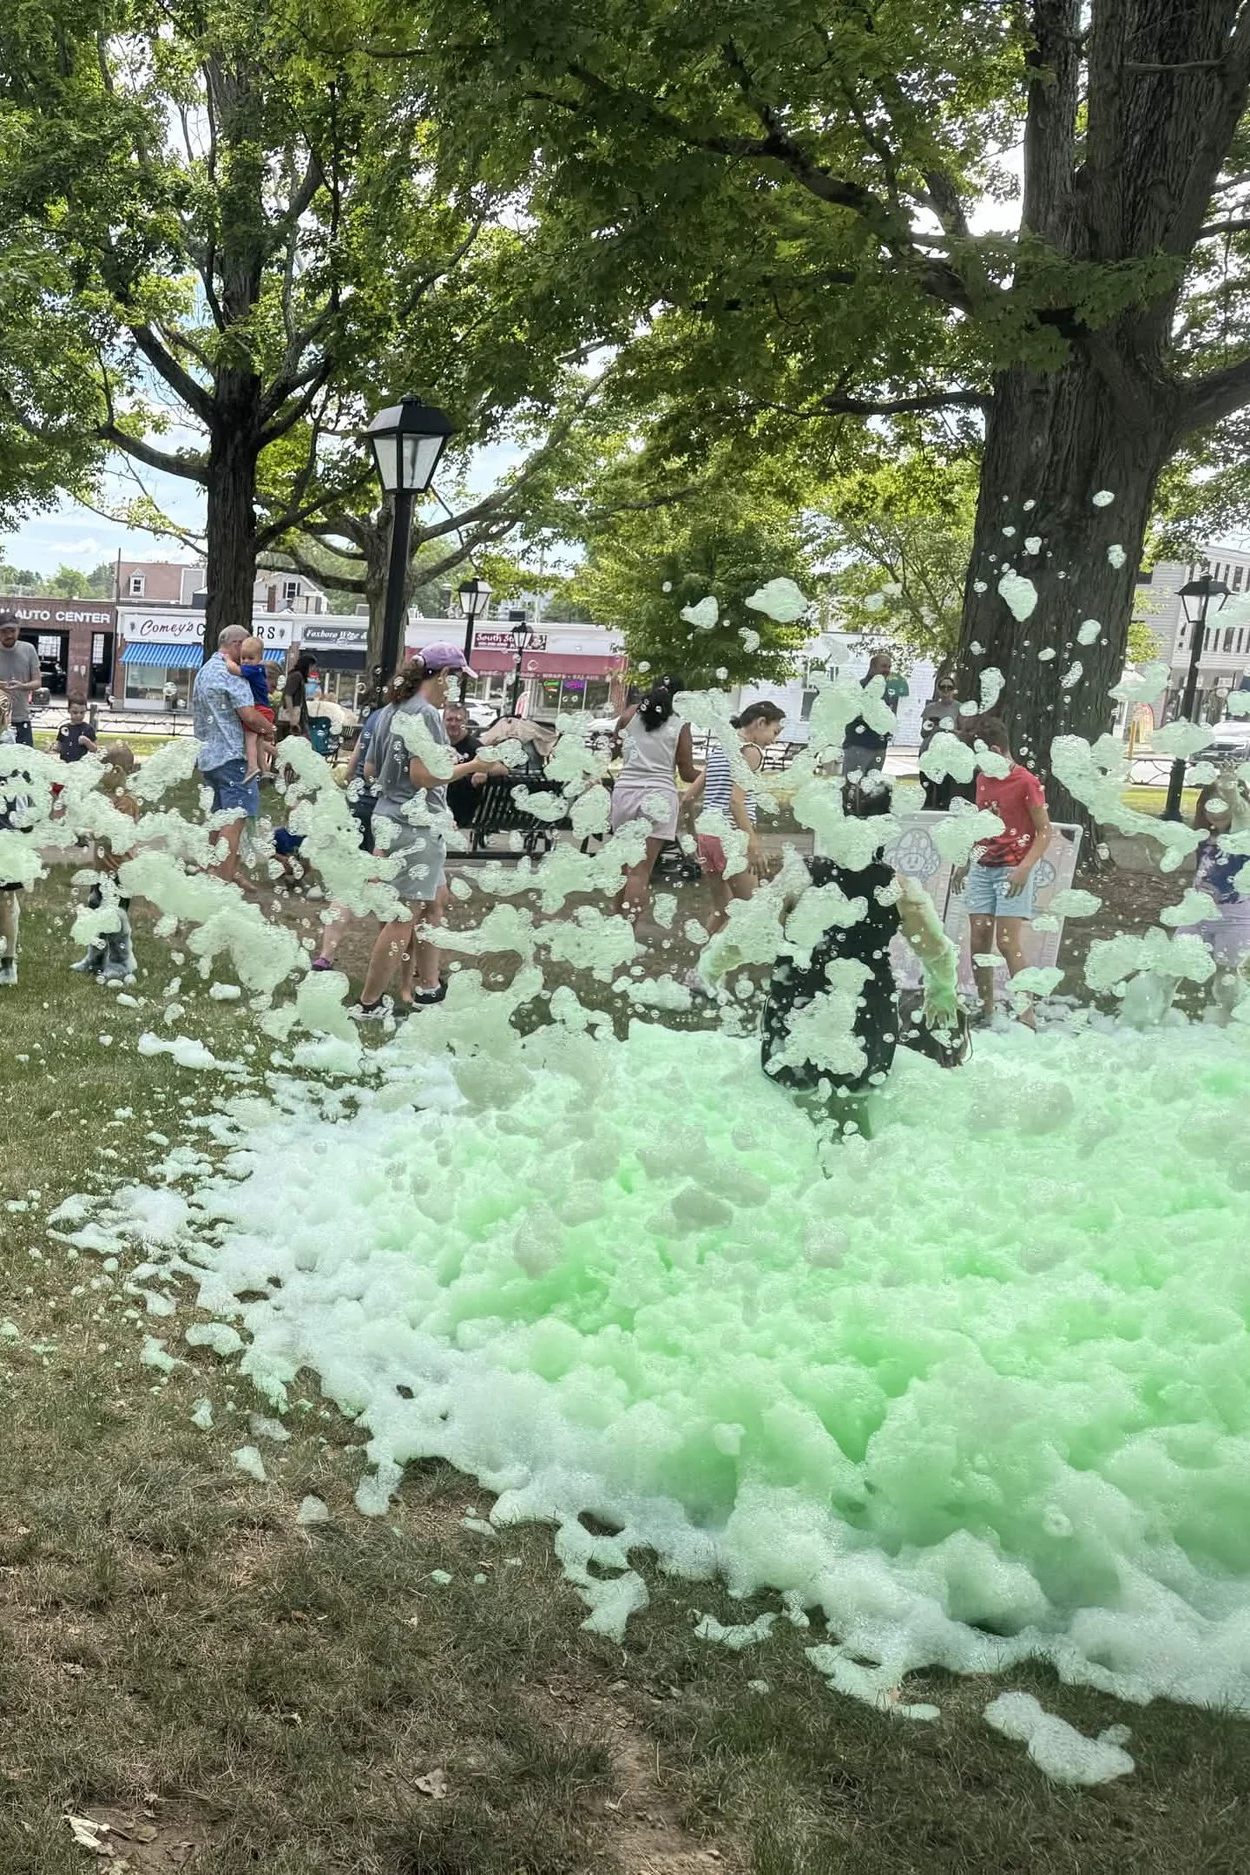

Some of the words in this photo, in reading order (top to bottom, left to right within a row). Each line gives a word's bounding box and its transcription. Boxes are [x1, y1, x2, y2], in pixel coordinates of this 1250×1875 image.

[15, 610, 50, 620] AUTO
[55, 611, 111, 624] CENTER
[140, 619, 194, 637] Comey's
